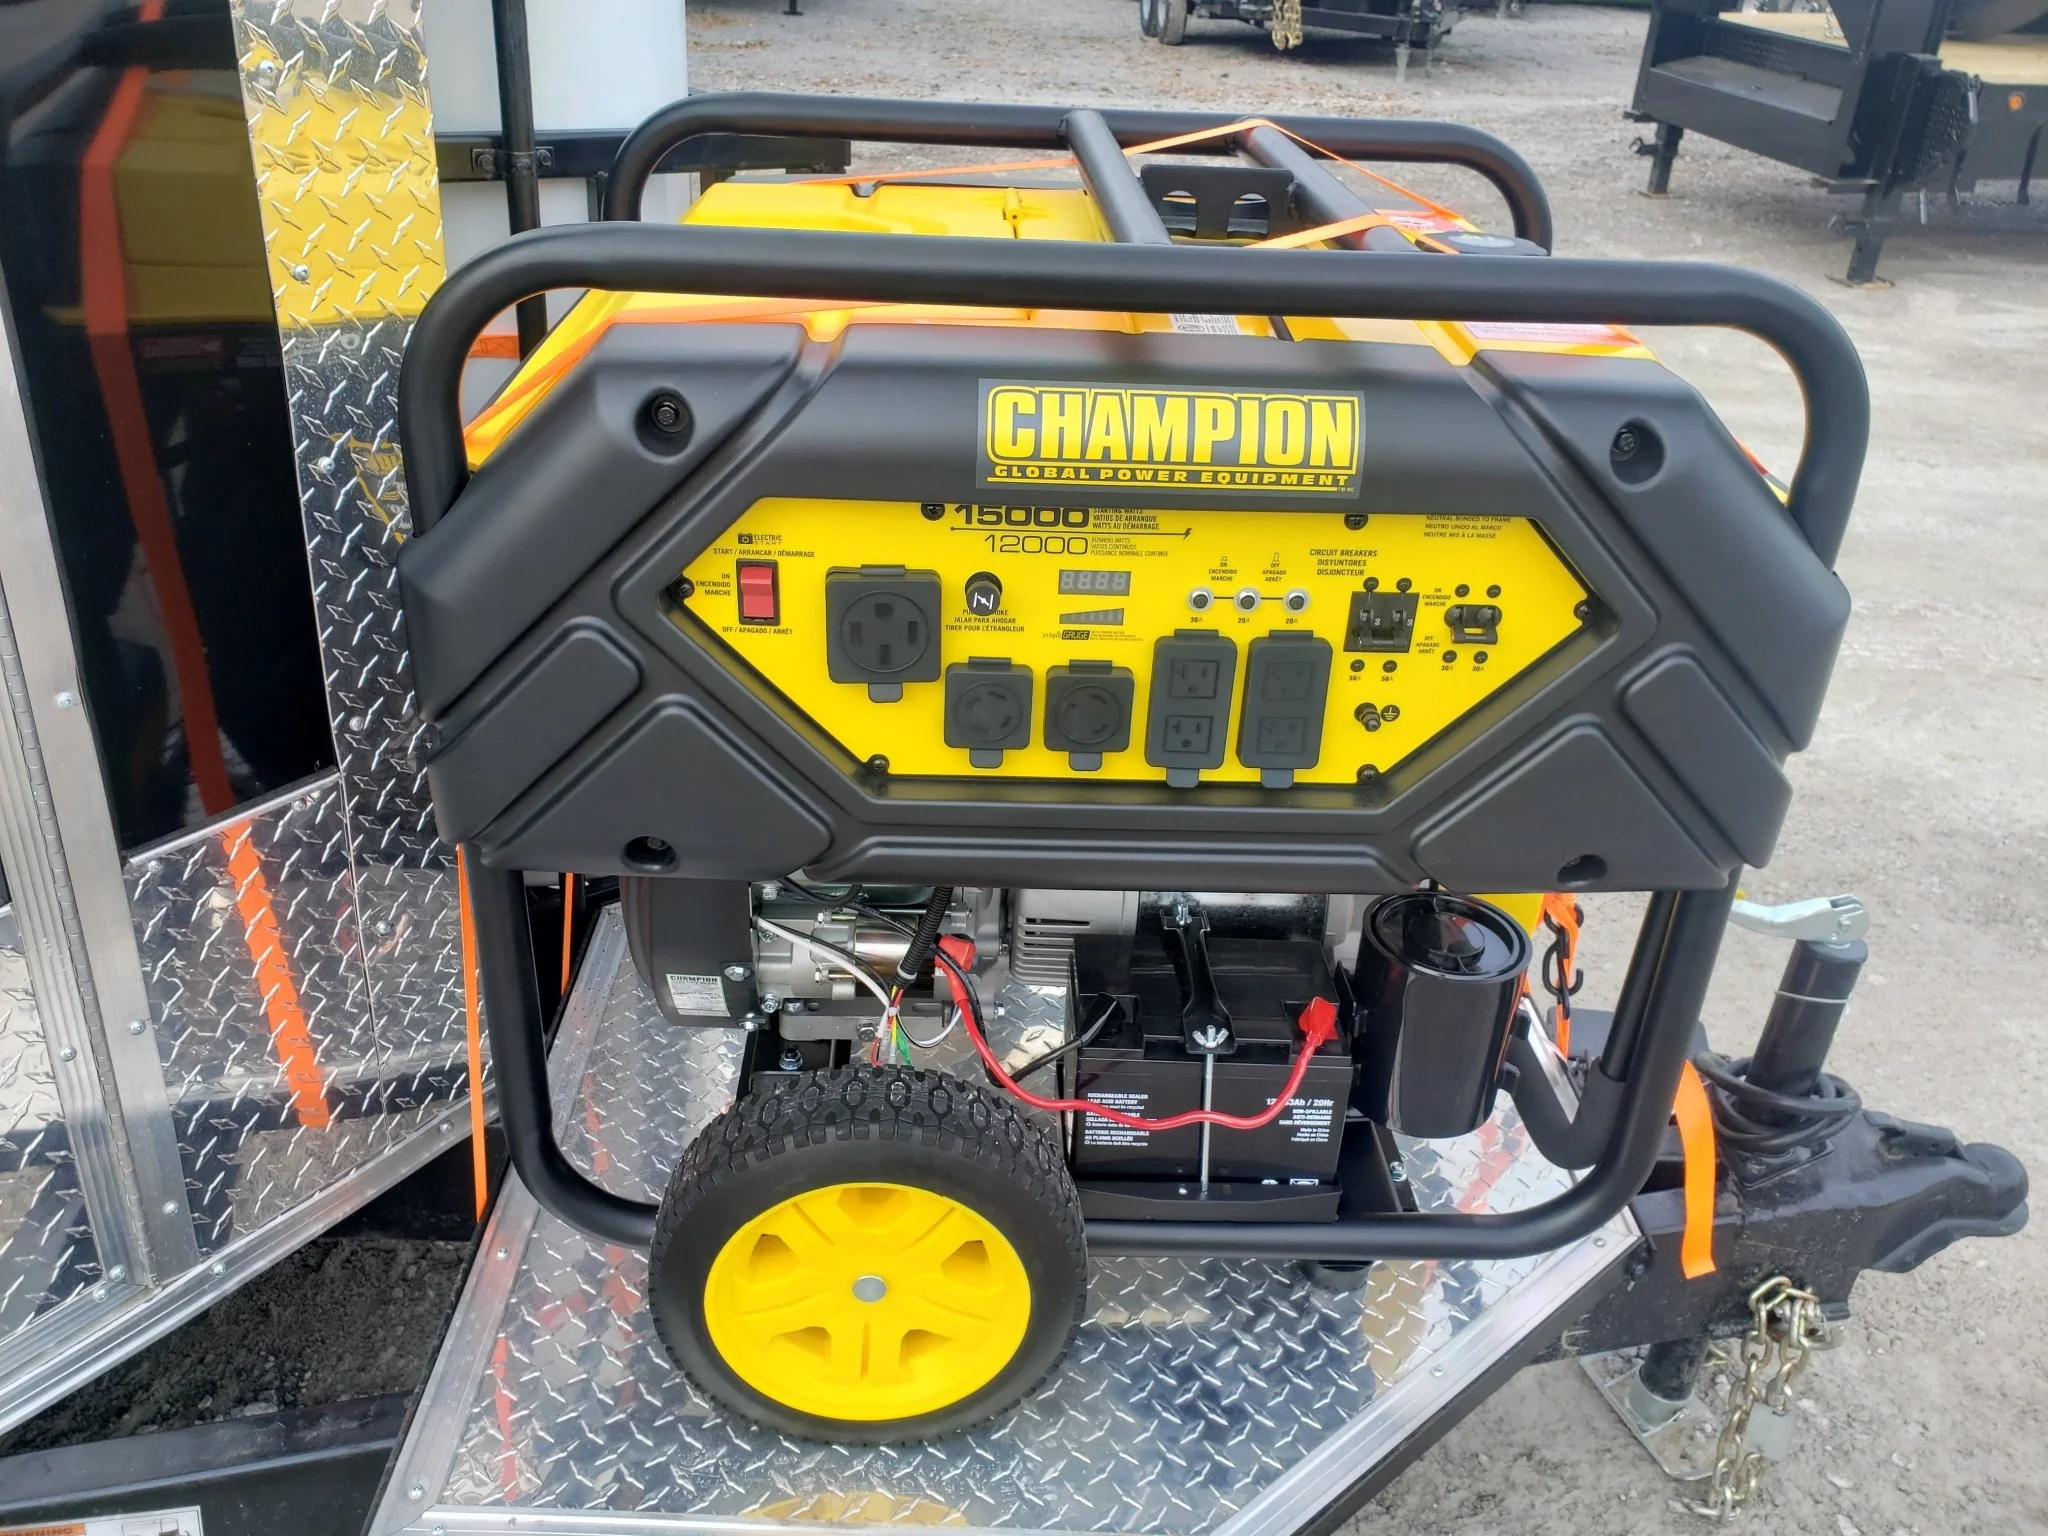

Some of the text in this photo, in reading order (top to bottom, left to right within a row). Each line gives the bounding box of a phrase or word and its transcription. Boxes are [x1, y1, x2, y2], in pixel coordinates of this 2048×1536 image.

[993, 389, 1352, 468] CHAMPION
[994, 465, 1350, 486] GLOBAL POWER EQUIPMENT
[954, 504, 1090, 528] 15000
[1122, 522, 1160, 530] DÉMARRAGE
[778, 549, 815, 558] DÉMARRAGE
[984, 534, 1089, 555] 12000
[1317, 559, 1367, 567] DISYUNTORES
